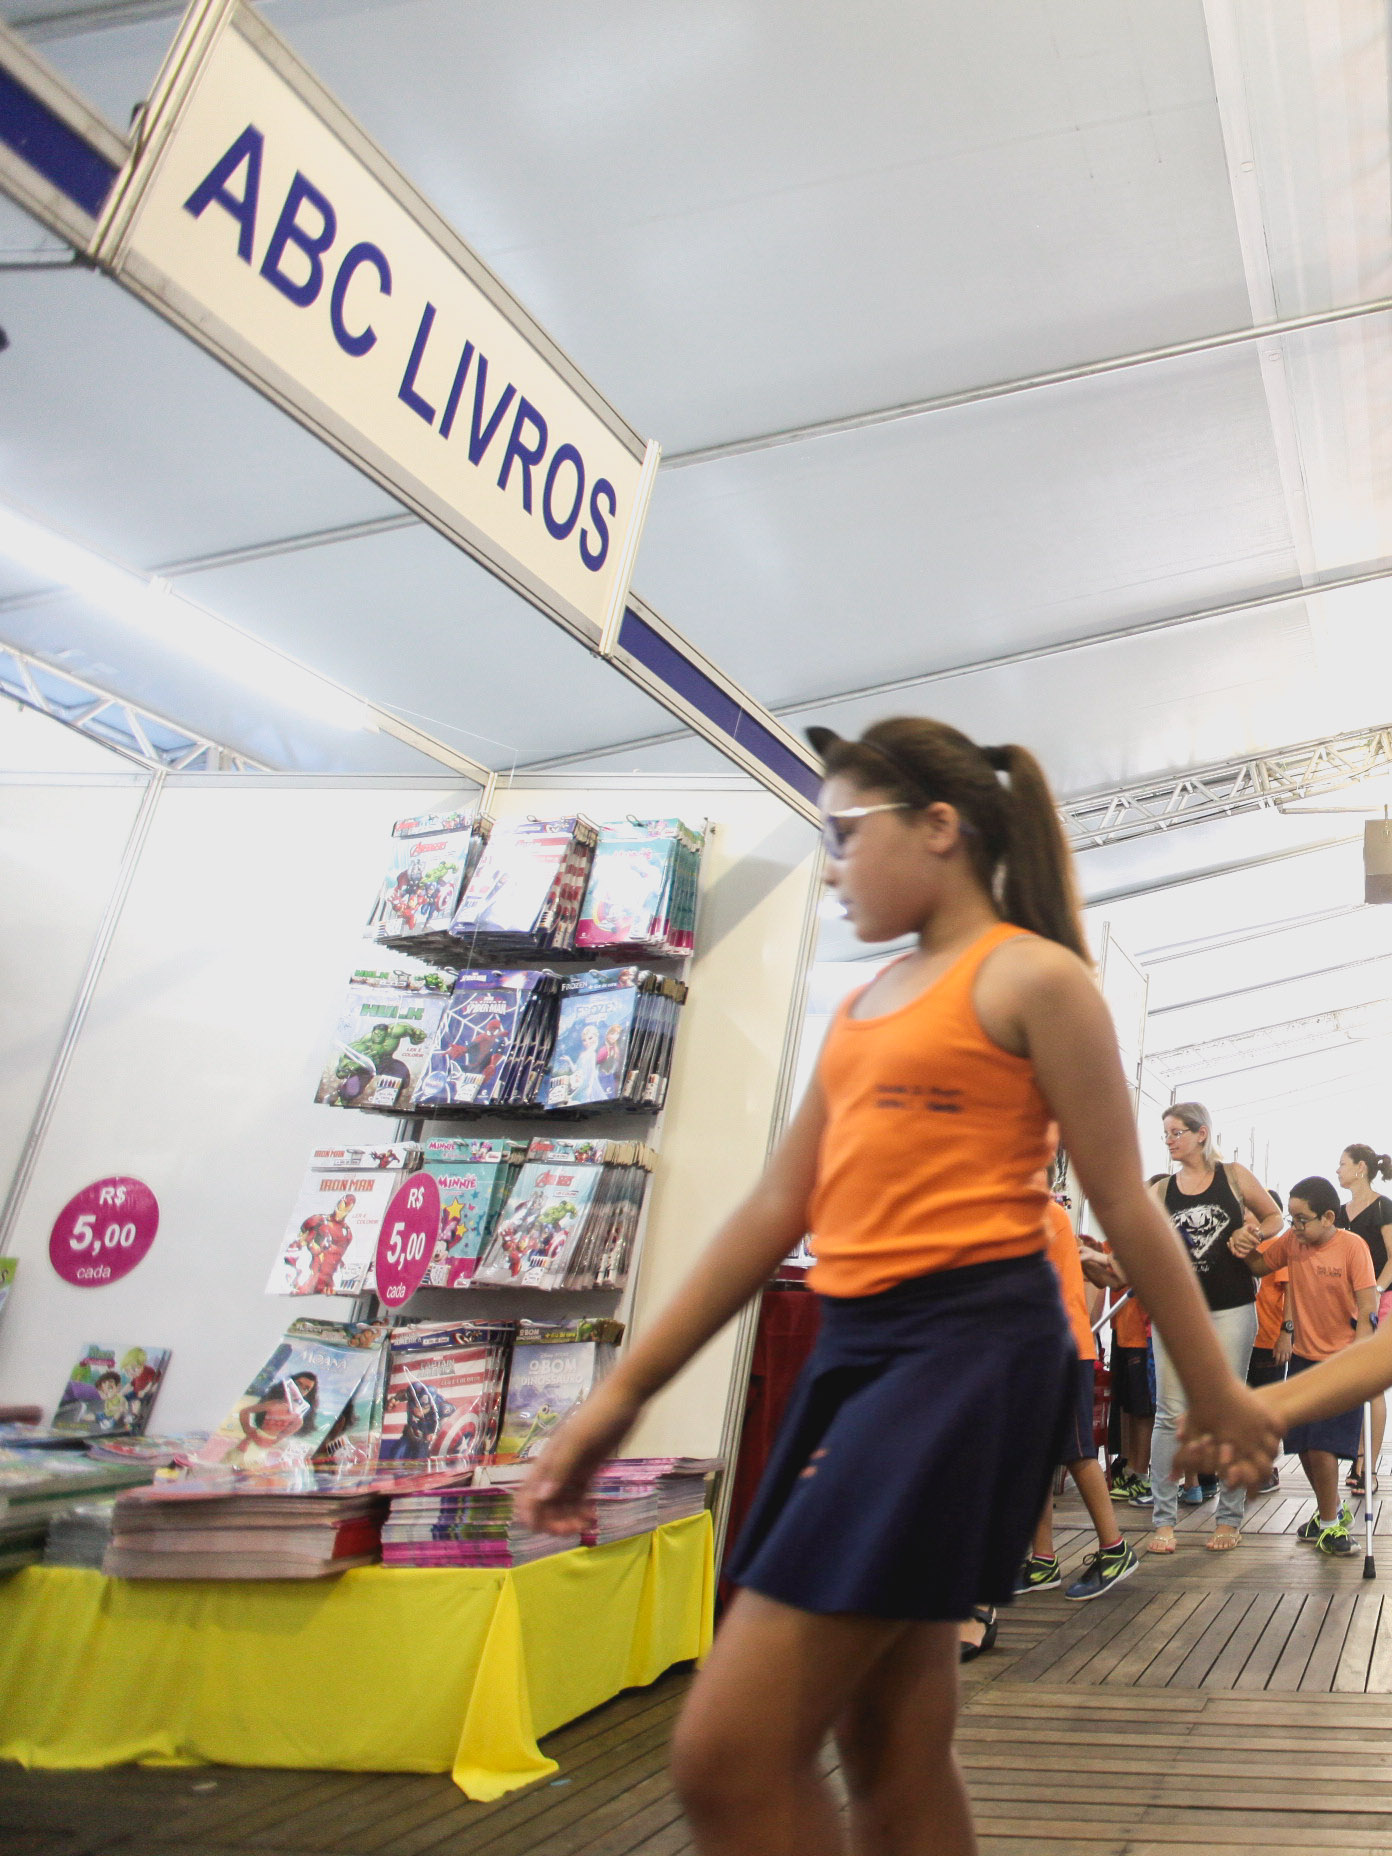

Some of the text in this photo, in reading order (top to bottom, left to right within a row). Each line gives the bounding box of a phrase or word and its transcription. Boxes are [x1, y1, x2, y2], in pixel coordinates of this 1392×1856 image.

[182, 122, 618, 573] ABC LIVROS
[360, 1003, 425, 1020] HULK
[428, 1141, 455, 1151] MINNIE
[319, 1179, 376, 1192] IRON MAN
[438, 1175, 478, 1190] MINNIE
[99, 1185, 127, 1207] R$
[407, 1186, 425, 1209] R$
[69, 1214, 137, 1256] 5,00
[387, 1222, 426, 1270] 5,00
[76, 1265, 112, 1278] cada
[386, 1282, 407, 1298] cada
[541, 1359, 577, 1374] BOM
